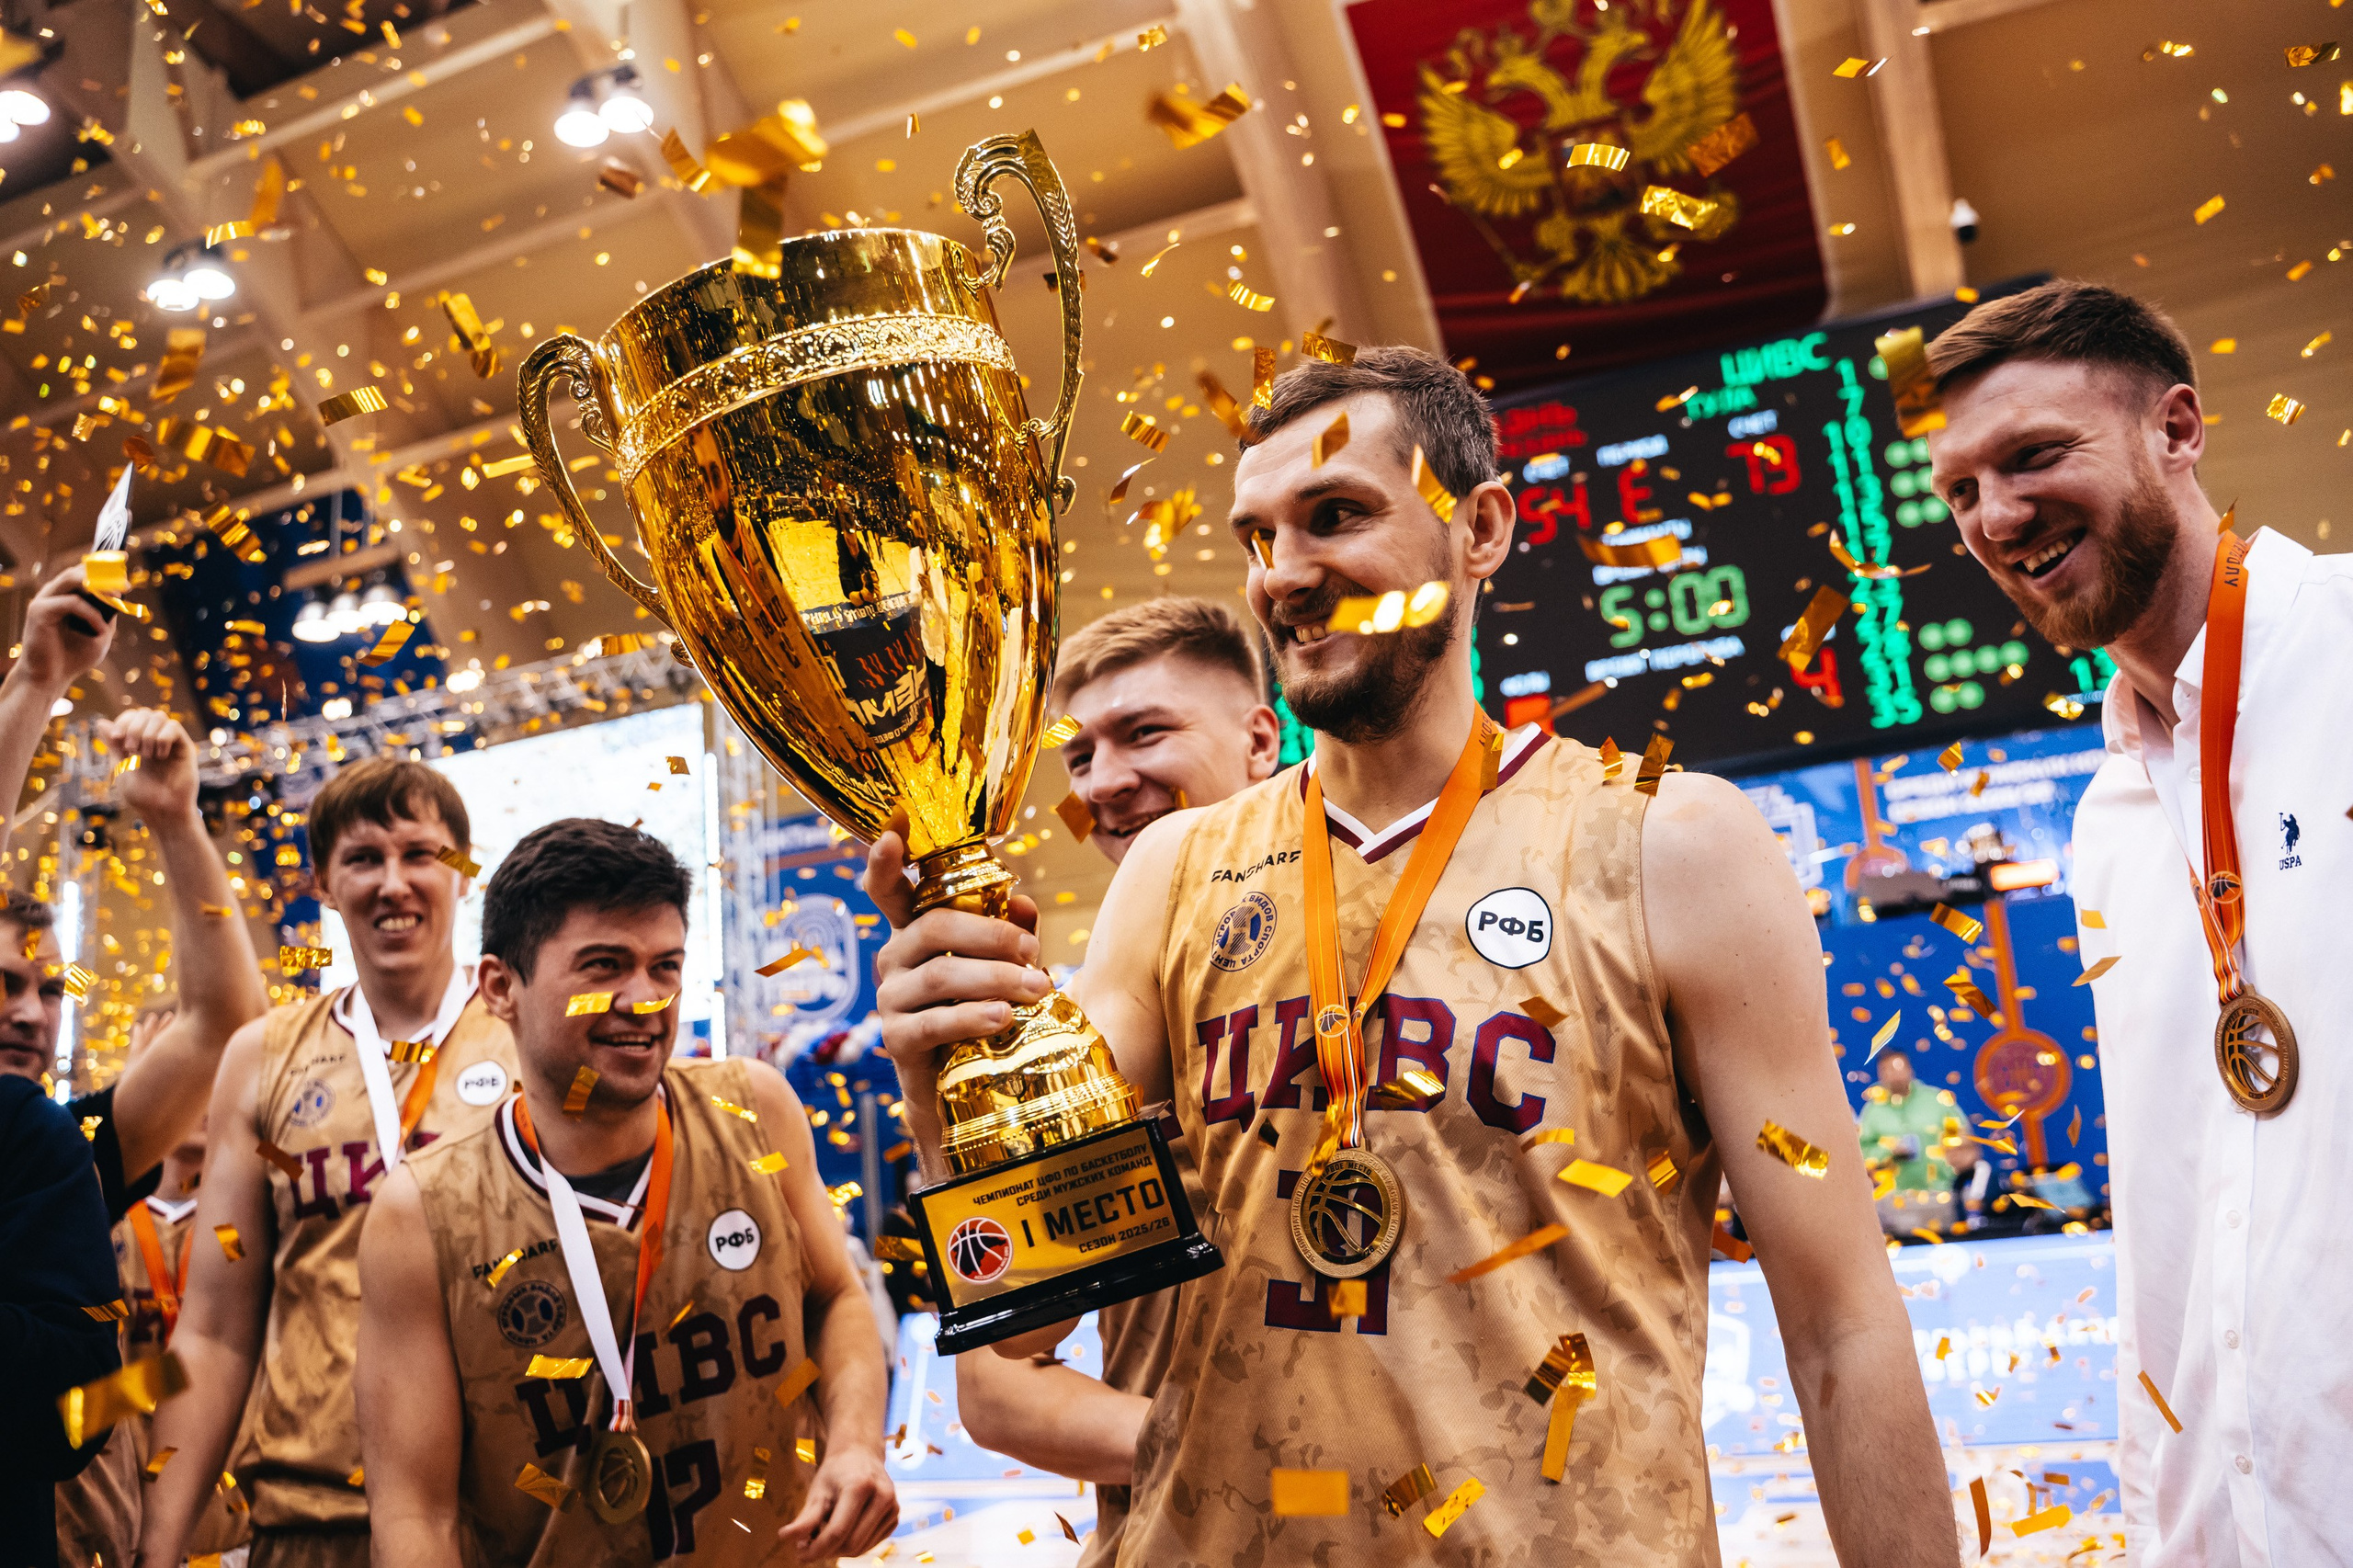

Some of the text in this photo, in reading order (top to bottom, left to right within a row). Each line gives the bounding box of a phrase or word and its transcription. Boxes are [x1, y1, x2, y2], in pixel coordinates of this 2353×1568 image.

[1518, 483, 1591, 545] 54
[1600, 564, 1750, 648] 5:00
[2279, 855, 2302, 870] USPA
[1248, 894, 1275, 922] ВИДОВ
[1477, 911, 1544, 944] РФБ
[1241, 925, 1273, 965] СПОРТА
[972, 1143, 1148, 1206] ЧЕМПИОНАТ ЦФО ПО БАСКЕТБОЛУ
[1016, 1155, 1154, 1207] СРЕДИ МУЖСКИХ КОМАНД
[1347, 1161, 1372, 1176] МЕСТО
[1044, 1177, 1165, 1242] МЕСТО
[714, 1227, 755, 1252] РФБ
[1079, 1216, 1170, 1254] СЕЗОН 2025/26
